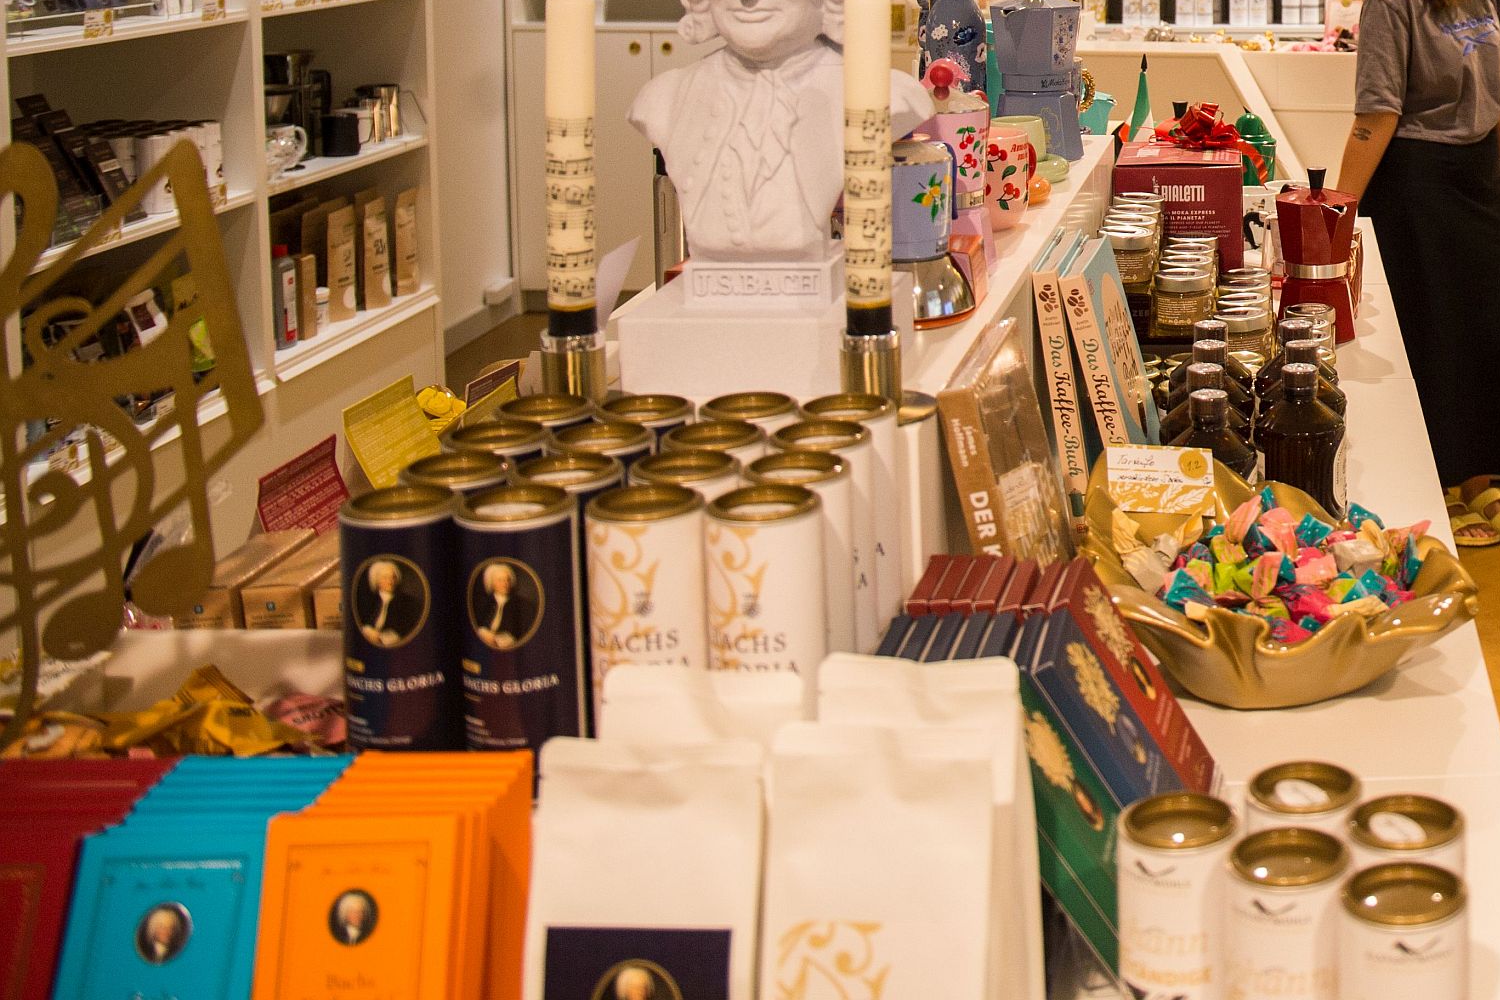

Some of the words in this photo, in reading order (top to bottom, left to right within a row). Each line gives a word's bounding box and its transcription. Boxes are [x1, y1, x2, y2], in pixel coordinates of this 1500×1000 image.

[1049, 335, 1065, 368] Das
[1053, 371, 1081, 478] Kaffee-Buch
[1082, 338, 1100, 371] Das
[1091, 374, 1125, 444] Kaffee-
[969, 490, 997, 540] DER
